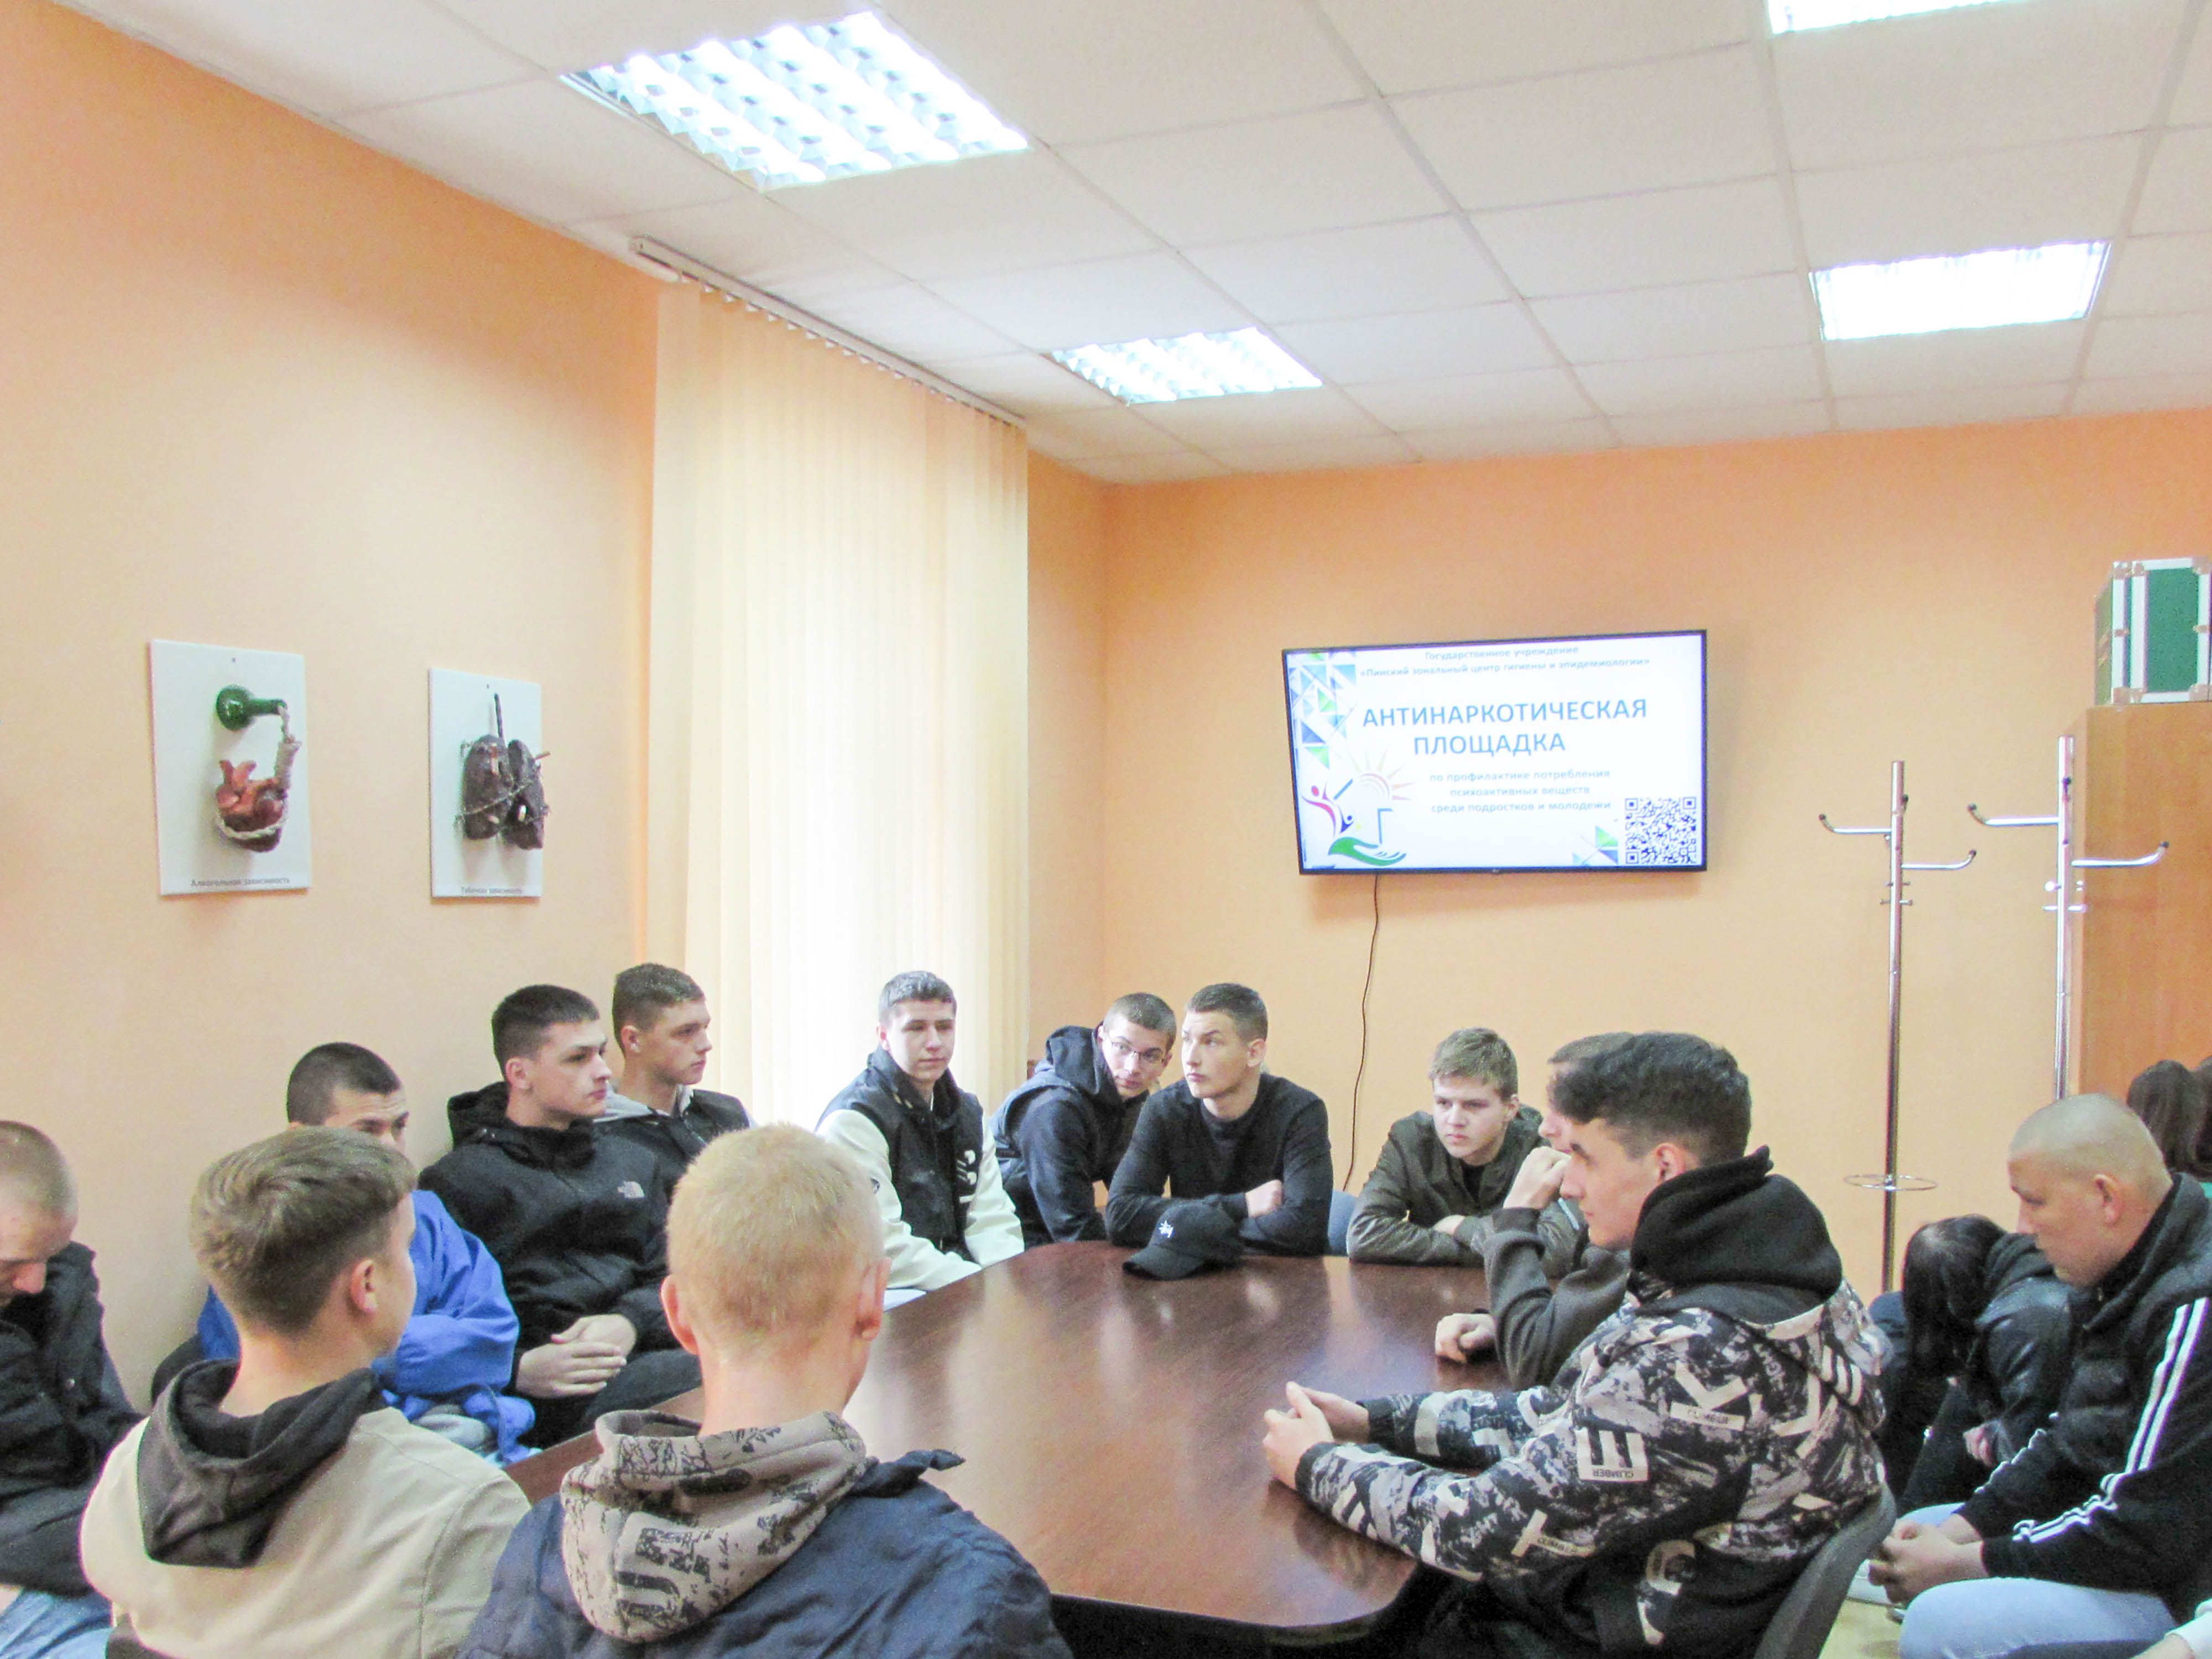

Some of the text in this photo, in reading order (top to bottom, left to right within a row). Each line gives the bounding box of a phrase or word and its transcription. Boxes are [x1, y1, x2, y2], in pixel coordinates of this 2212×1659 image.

[1425, 646, 1579, 660] Государственное учреждение
[1413, 664, 1468, 674] зональный
[1471, 664, 1500, 673] центр
[1504, 663, 1546, 671] гигиены
[1363, 698, 1647, 727] АНТИНАРКОТИЧЕСКАЯ
[1414, 732, 1566, 757] ПЛОЩАДКА
[1447, 772, 1530, 782] профилактике
[1534, 769, 1610, 780] потребления
[1451, 786, 1590, 796] психоактивных веществ
[1431, 805, 1464, 813] среди
[1468, 804, 1534, 813] подростков
[1549, 802, 1611, 811] молодежи
